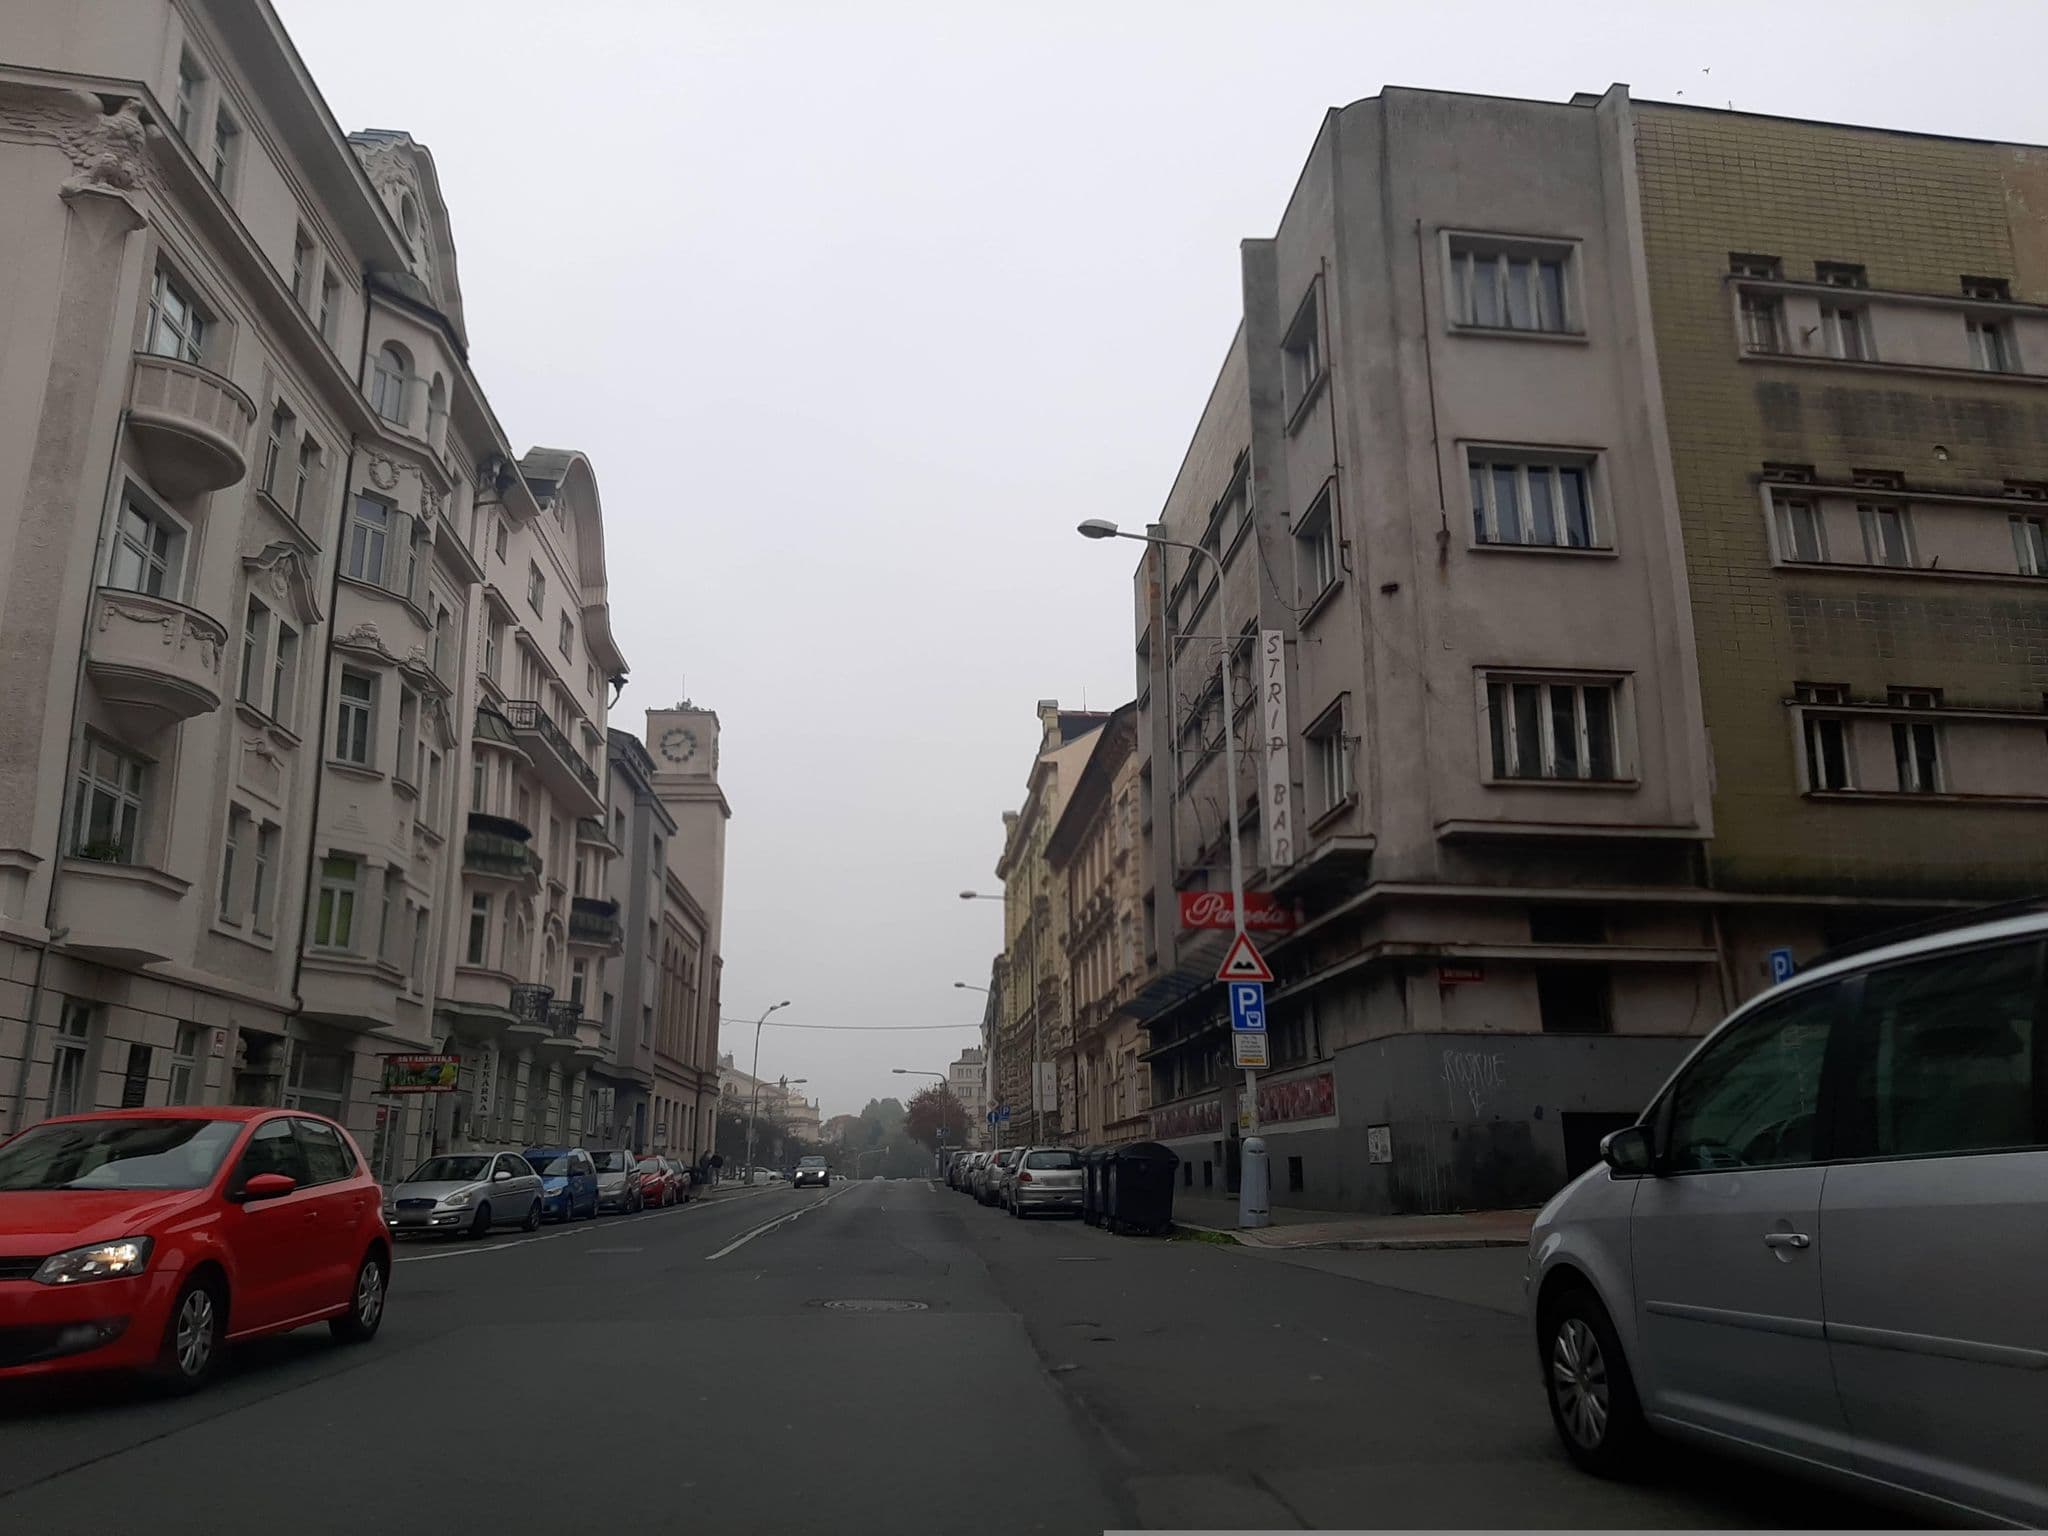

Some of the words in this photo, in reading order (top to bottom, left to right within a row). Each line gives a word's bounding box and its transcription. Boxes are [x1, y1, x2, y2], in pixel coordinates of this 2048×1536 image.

[1266, 635, 1284, 758] STRIP
[1273, 784, 1289, 861] BAR
[1774, 955, 1787, 984] P
[1238, 987, 1258, 1016] P
